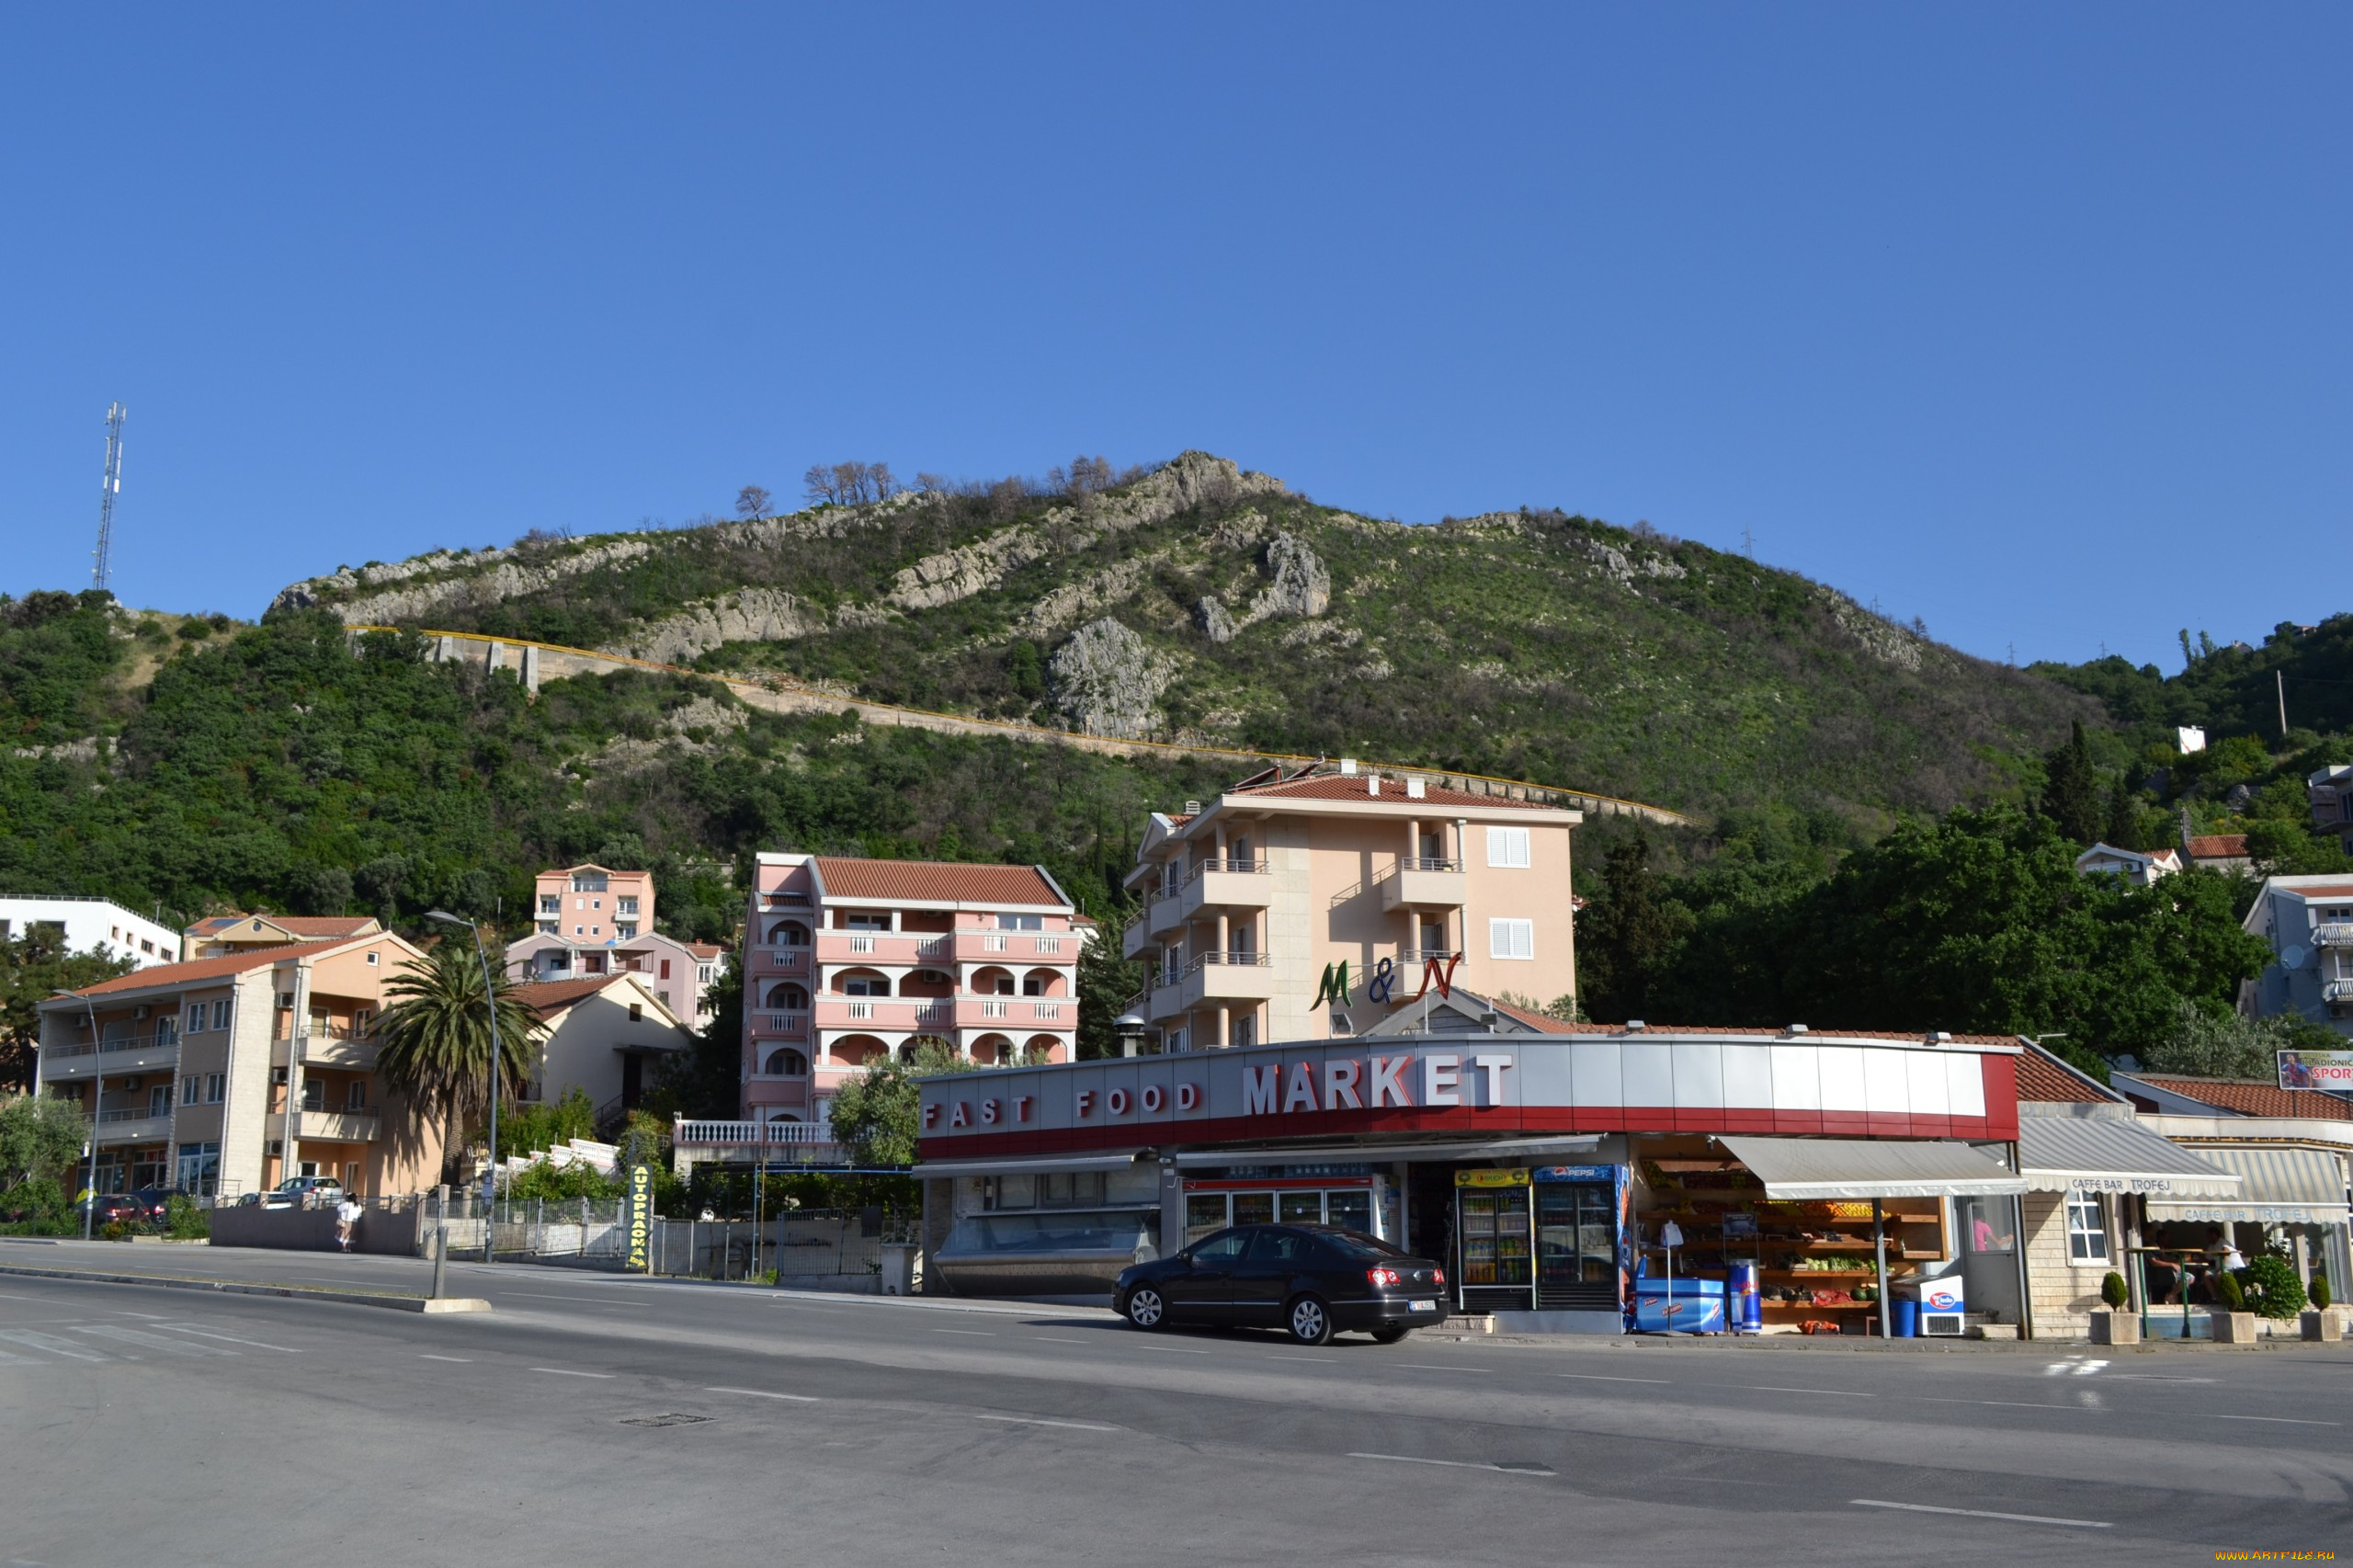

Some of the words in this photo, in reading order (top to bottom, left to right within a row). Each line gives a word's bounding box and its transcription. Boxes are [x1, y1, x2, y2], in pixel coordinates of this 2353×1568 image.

[1309, 959, 1353, 1011] M
[1369, 957, 1395, 1005] &
[1411, 951, 1462, 1004] N
[2313, 1068, 2353, 1079] SPOR
[922, 1095, 1032, 1130] FAST
[1075, 1083, 1200, 1119] FOOD
[1242, 1054, 1513, 1117] MARKET
[2073, 1179, 2101, 1189] CAFFE
[2104, 1180, 2123, 1189] BAR
[2131, 1179, 2170, 1191] TROFEJ
[631, 1166, 649, 1256] AUTOPRAONA
[2185, 1210, 2221, 1220] CAFFE
[2224, 1210, 2245, 1220] BAR
[2255, 1208, 2310, 1221] TROFEJ
[1662, 1303, 1682, 1315] Frkom
